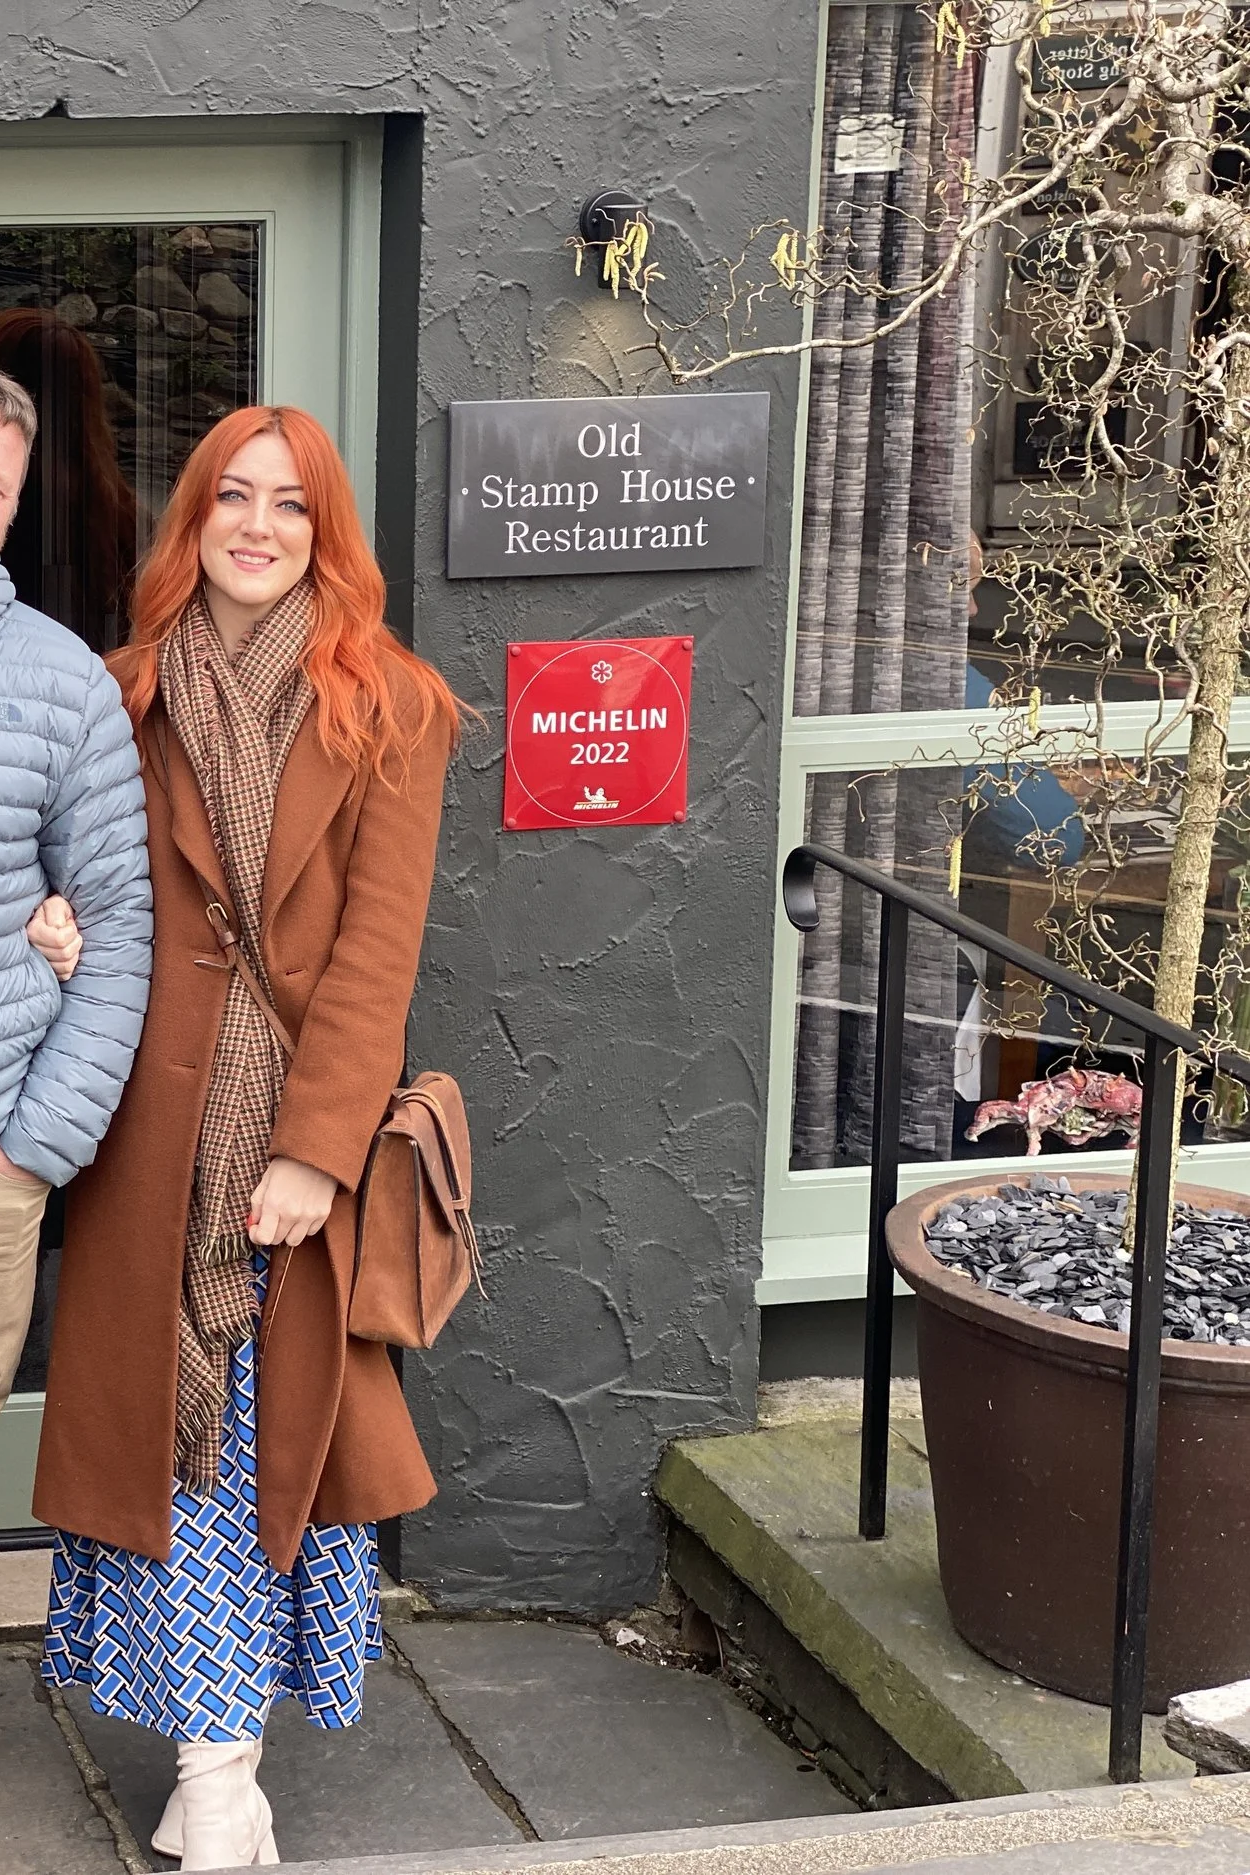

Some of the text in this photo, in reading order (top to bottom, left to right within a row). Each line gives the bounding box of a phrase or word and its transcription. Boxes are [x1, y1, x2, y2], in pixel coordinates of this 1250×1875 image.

[577, 421, 642, 458] Old
[481, 469, 736, 512] Stamp House
[504, 516, 709, 554] Restaurant
[532, 707, 668, 734] MICHELIN
[570, 741, 630, 765] 2022
[573, 802, 619, 810] MICHELIN
